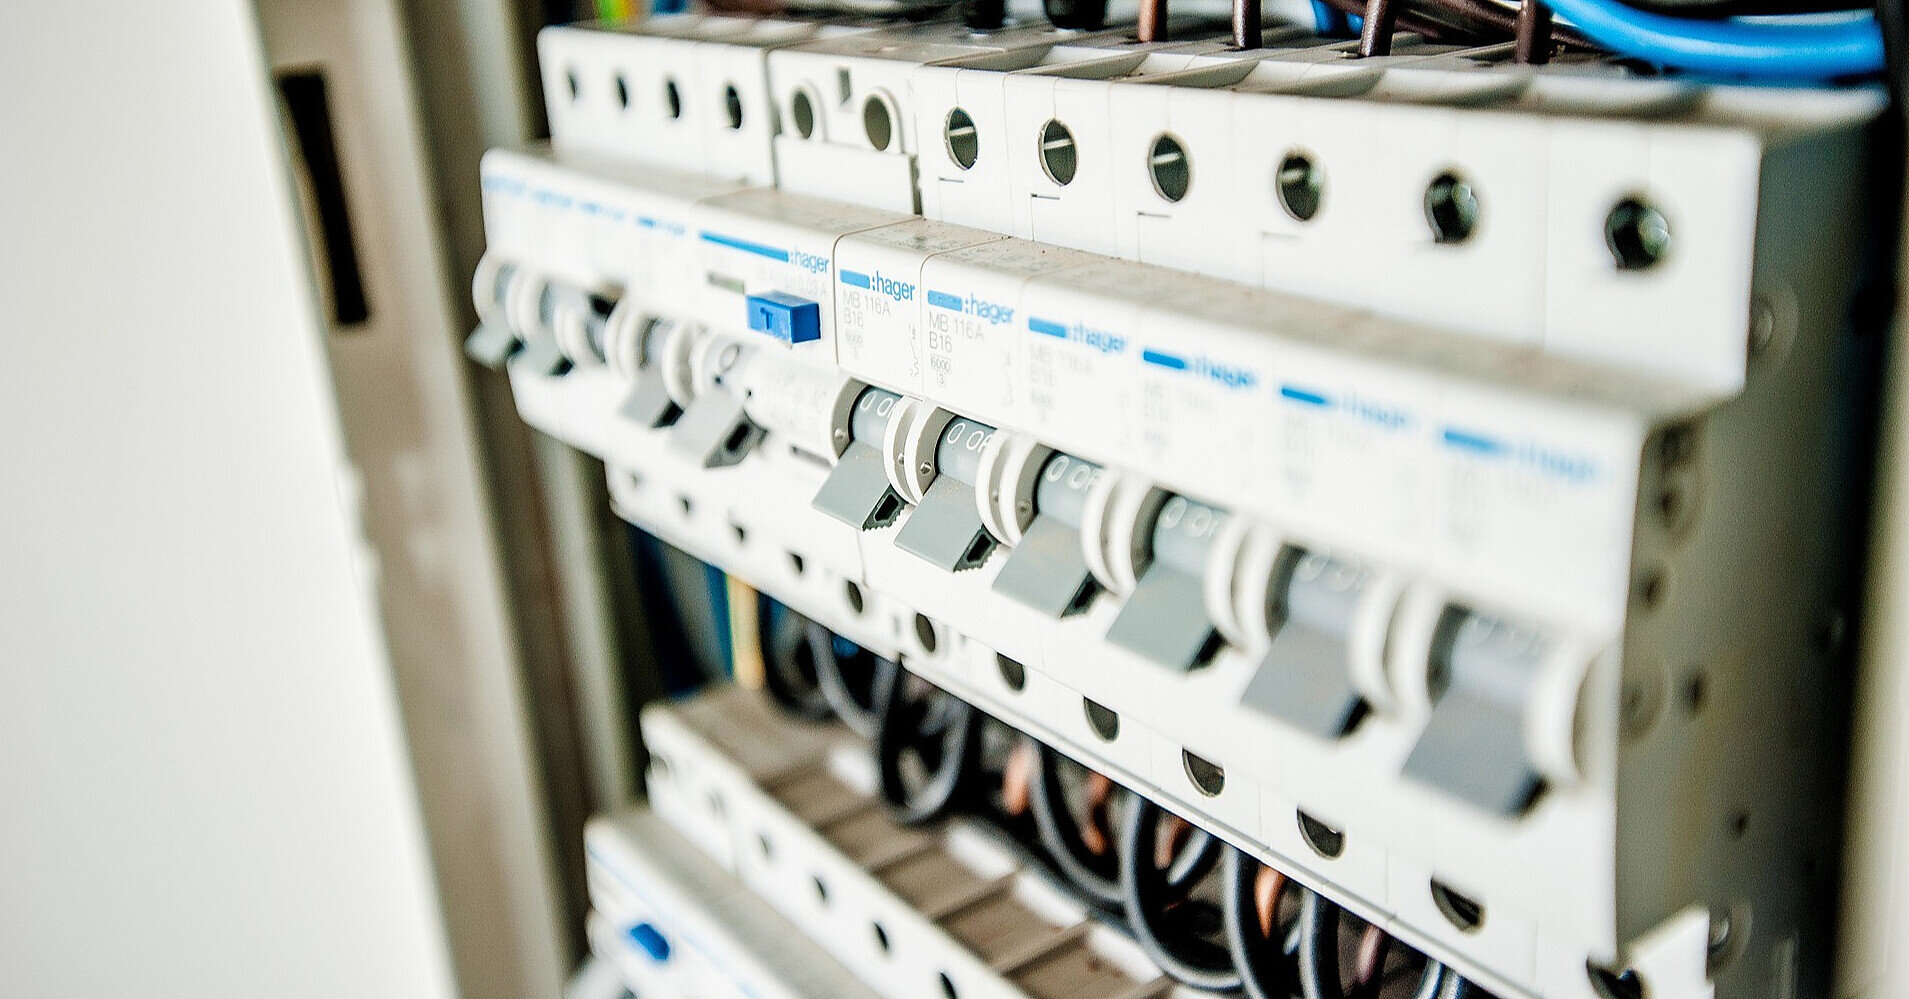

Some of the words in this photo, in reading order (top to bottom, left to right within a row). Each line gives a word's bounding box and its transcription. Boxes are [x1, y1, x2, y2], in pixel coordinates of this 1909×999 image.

[872, 271, 915, 301] :hager
[843, 290, 860, 308] MB
[864, 295, 891, 317] 116A
[965, 292, 1014, 324] :hager
[843, 307, 864, 328] B16
[929, 311, 949, 332] MB
[954, 319, 985, 342] 116A
[929, 331, 953, 353] B16
[877, 397, 896, 419] O
